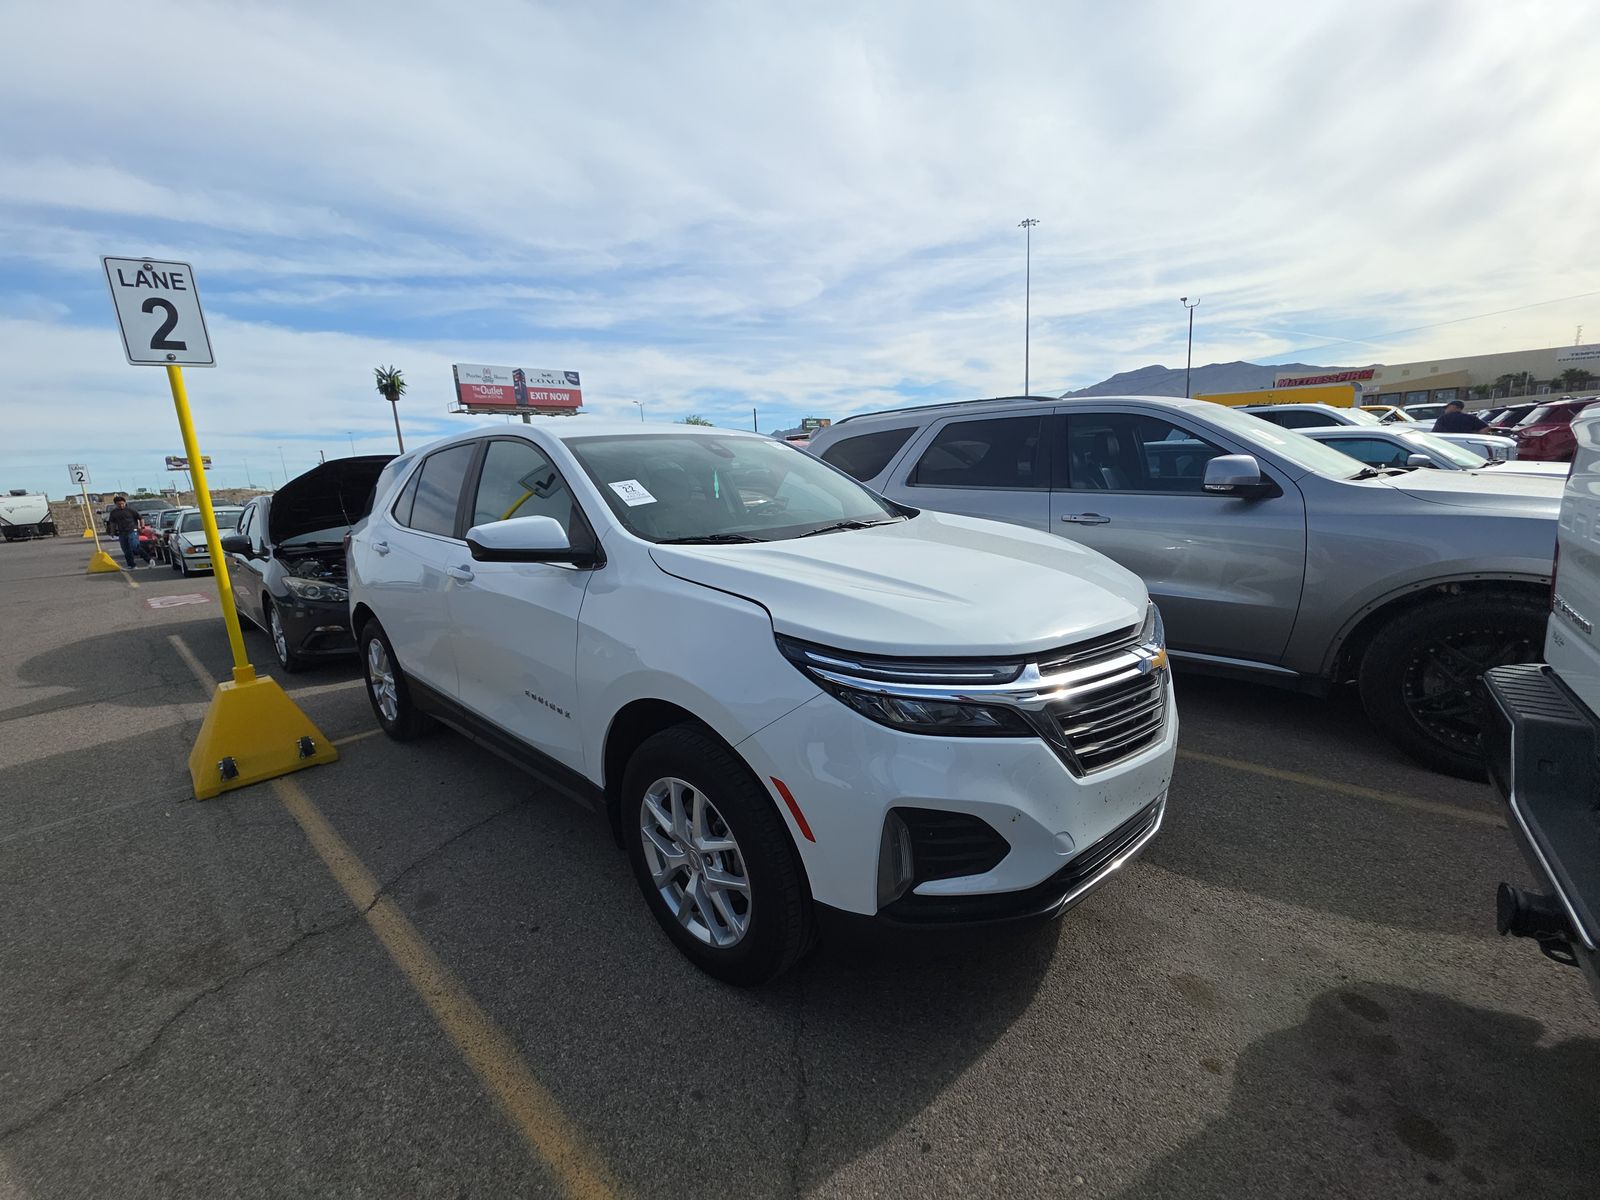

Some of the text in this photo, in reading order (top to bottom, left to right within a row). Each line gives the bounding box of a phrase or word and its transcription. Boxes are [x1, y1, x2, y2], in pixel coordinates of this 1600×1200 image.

[117, 268, 187, 291] LANE
[141, 297, 188, 351] 2
[480, 386, 504, 396] Outlet
[530, 392, 570, 401] EXIT NOW
[76, 472, 86, 482] 2
